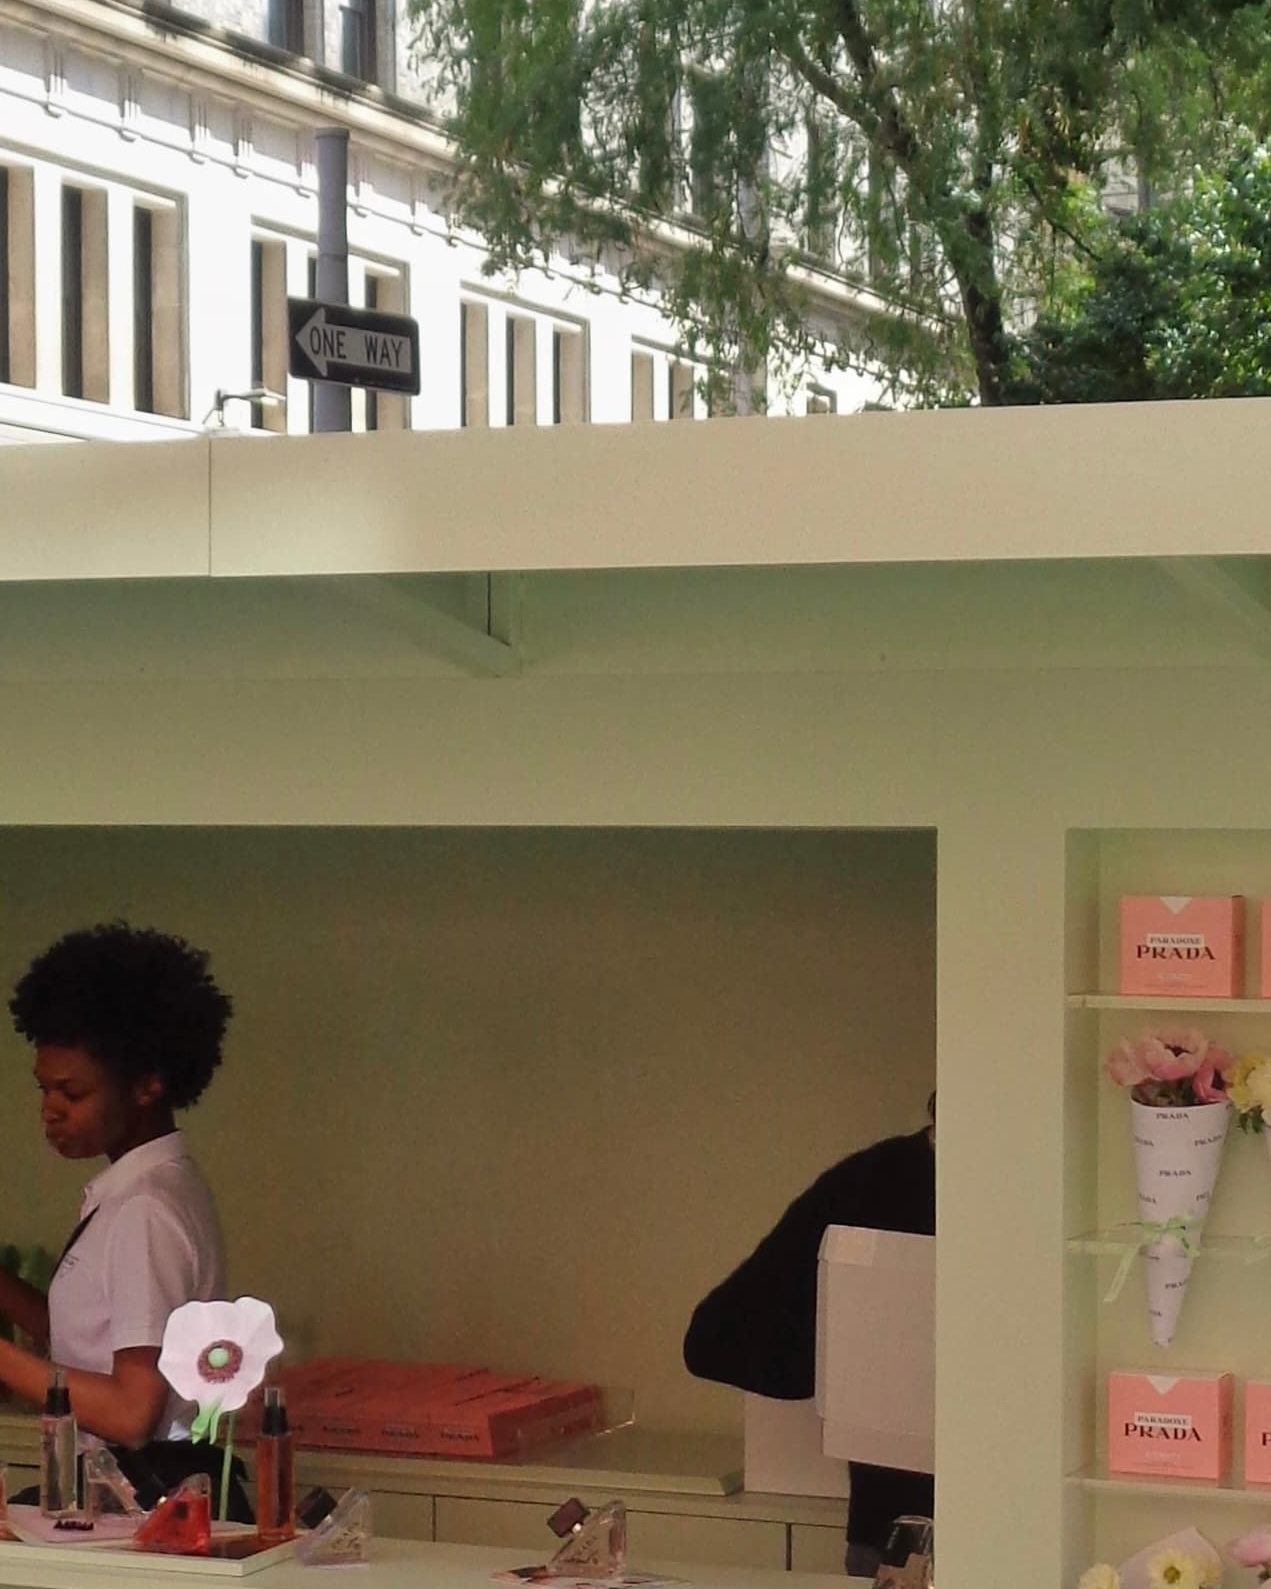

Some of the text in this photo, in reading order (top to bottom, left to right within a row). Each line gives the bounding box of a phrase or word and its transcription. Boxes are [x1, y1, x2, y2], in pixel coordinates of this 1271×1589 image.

[309, 326, 407, 368] ONE WAY
[1150, 936, 1201, 945] PARADOXE
[1136, 945, 1215, 960] PRADA
[1137, 1416, 1189, 1426] PARADOXE
[1125, 1423, 1202, 1442] PRADA
